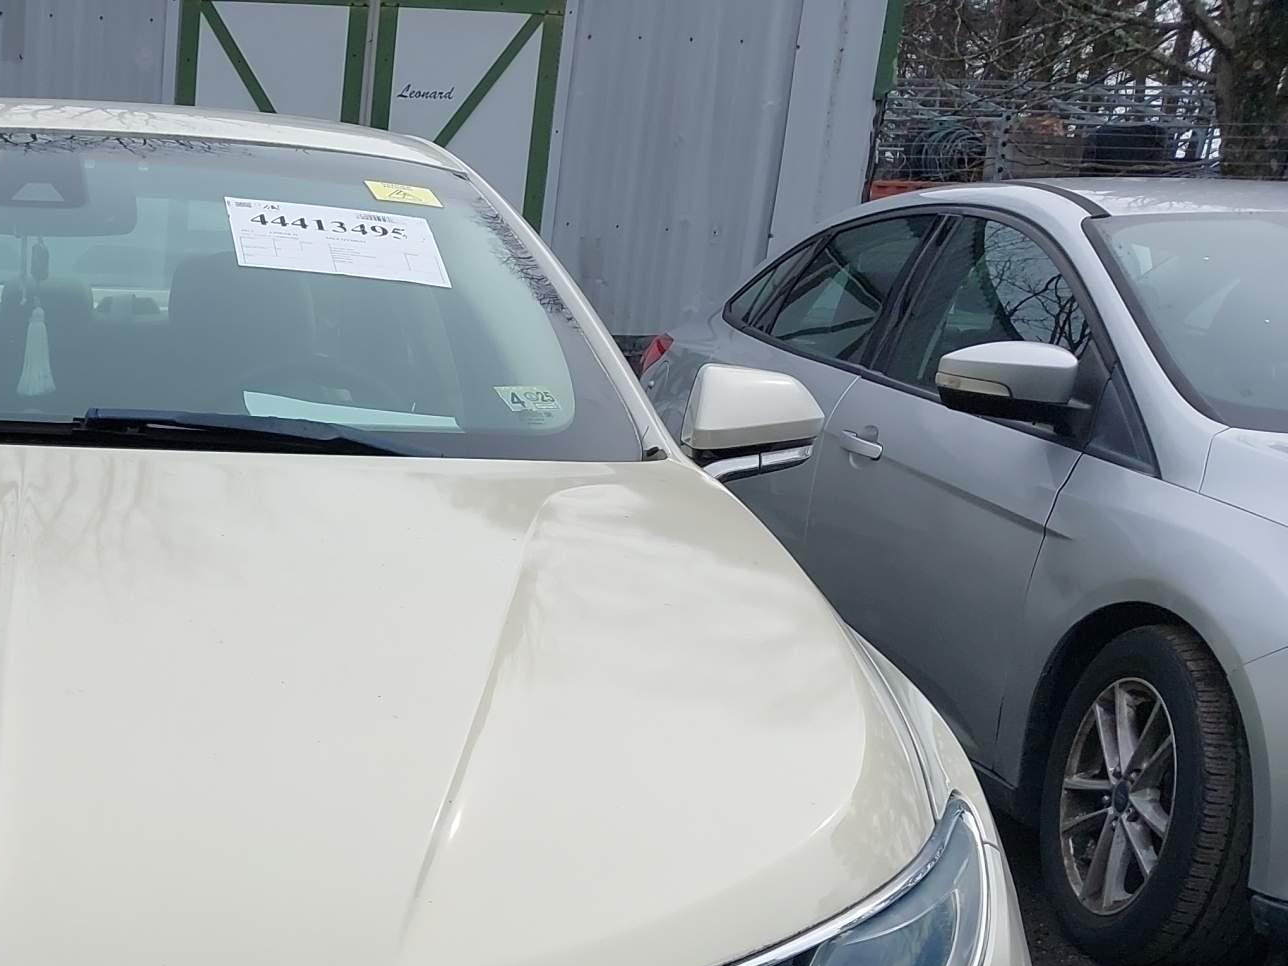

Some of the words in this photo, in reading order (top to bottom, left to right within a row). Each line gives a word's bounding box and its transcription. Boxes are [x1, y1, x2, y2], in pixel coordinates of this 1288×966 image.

[396, 84, 455, 100] Leonard
[250, 213, 408, 240] 44413495
[511, 391, 526, 408] 4
